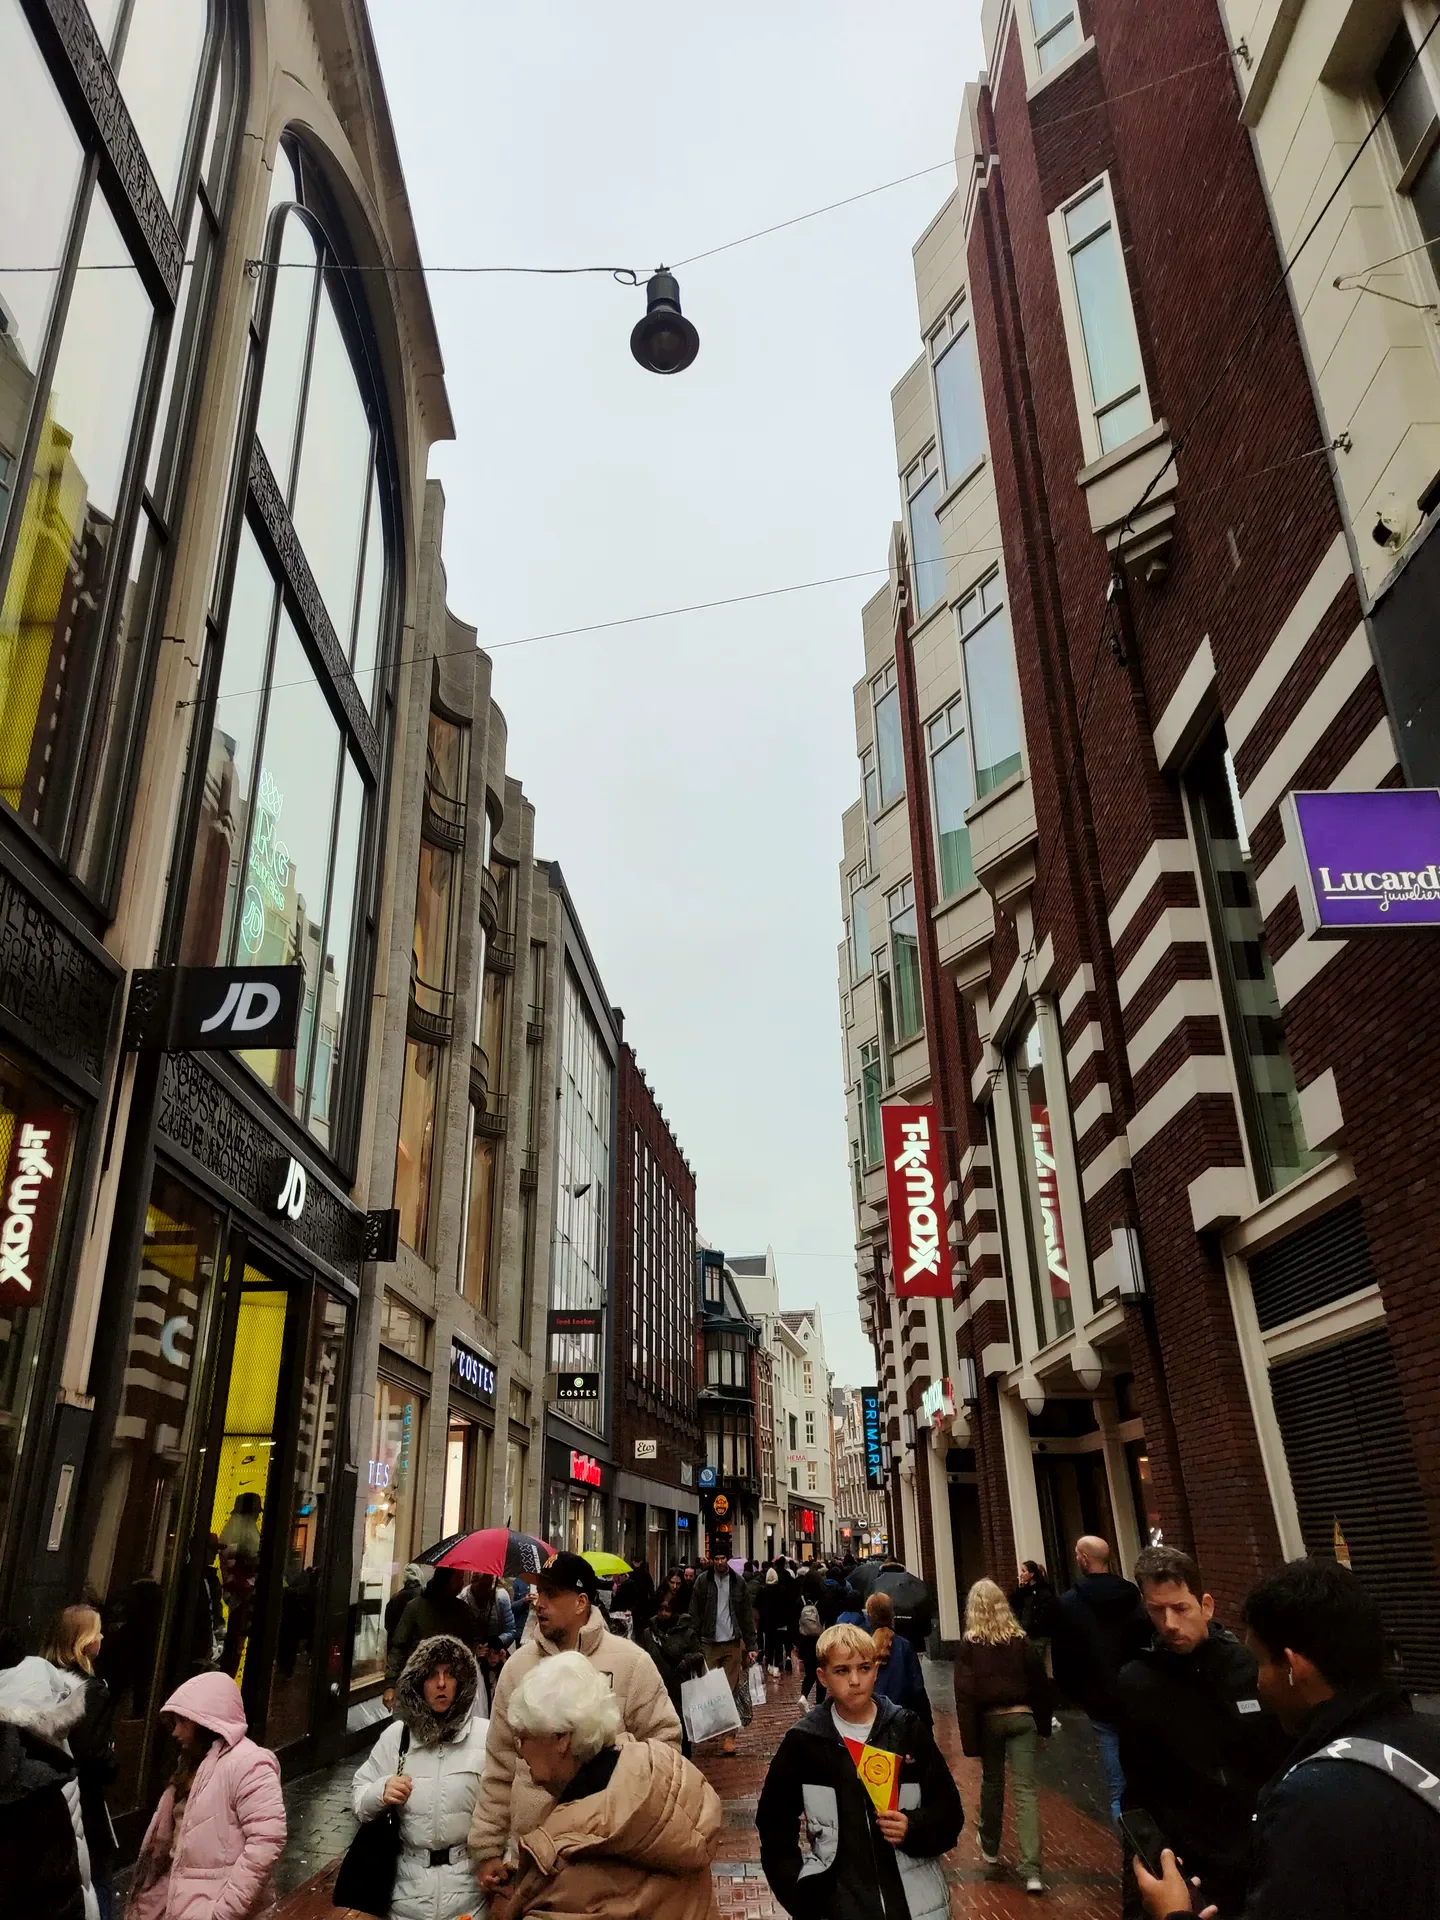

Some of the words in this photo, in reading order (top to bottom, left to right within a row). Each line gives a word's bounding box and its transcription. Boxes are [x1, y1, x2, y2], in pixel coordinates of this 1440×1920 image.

[1319, 865, 1440, 891] Lucard
[244, 900, 262, 938] JD
[200, 982, 281, 1033] JD
[276, 1157, 306, 1221] JD
[458, 1351, 494, 1395] COSTES
[560, 1389, 597, 1397] COSTES
[864, 1398, 880, 1477] PRIMARK
